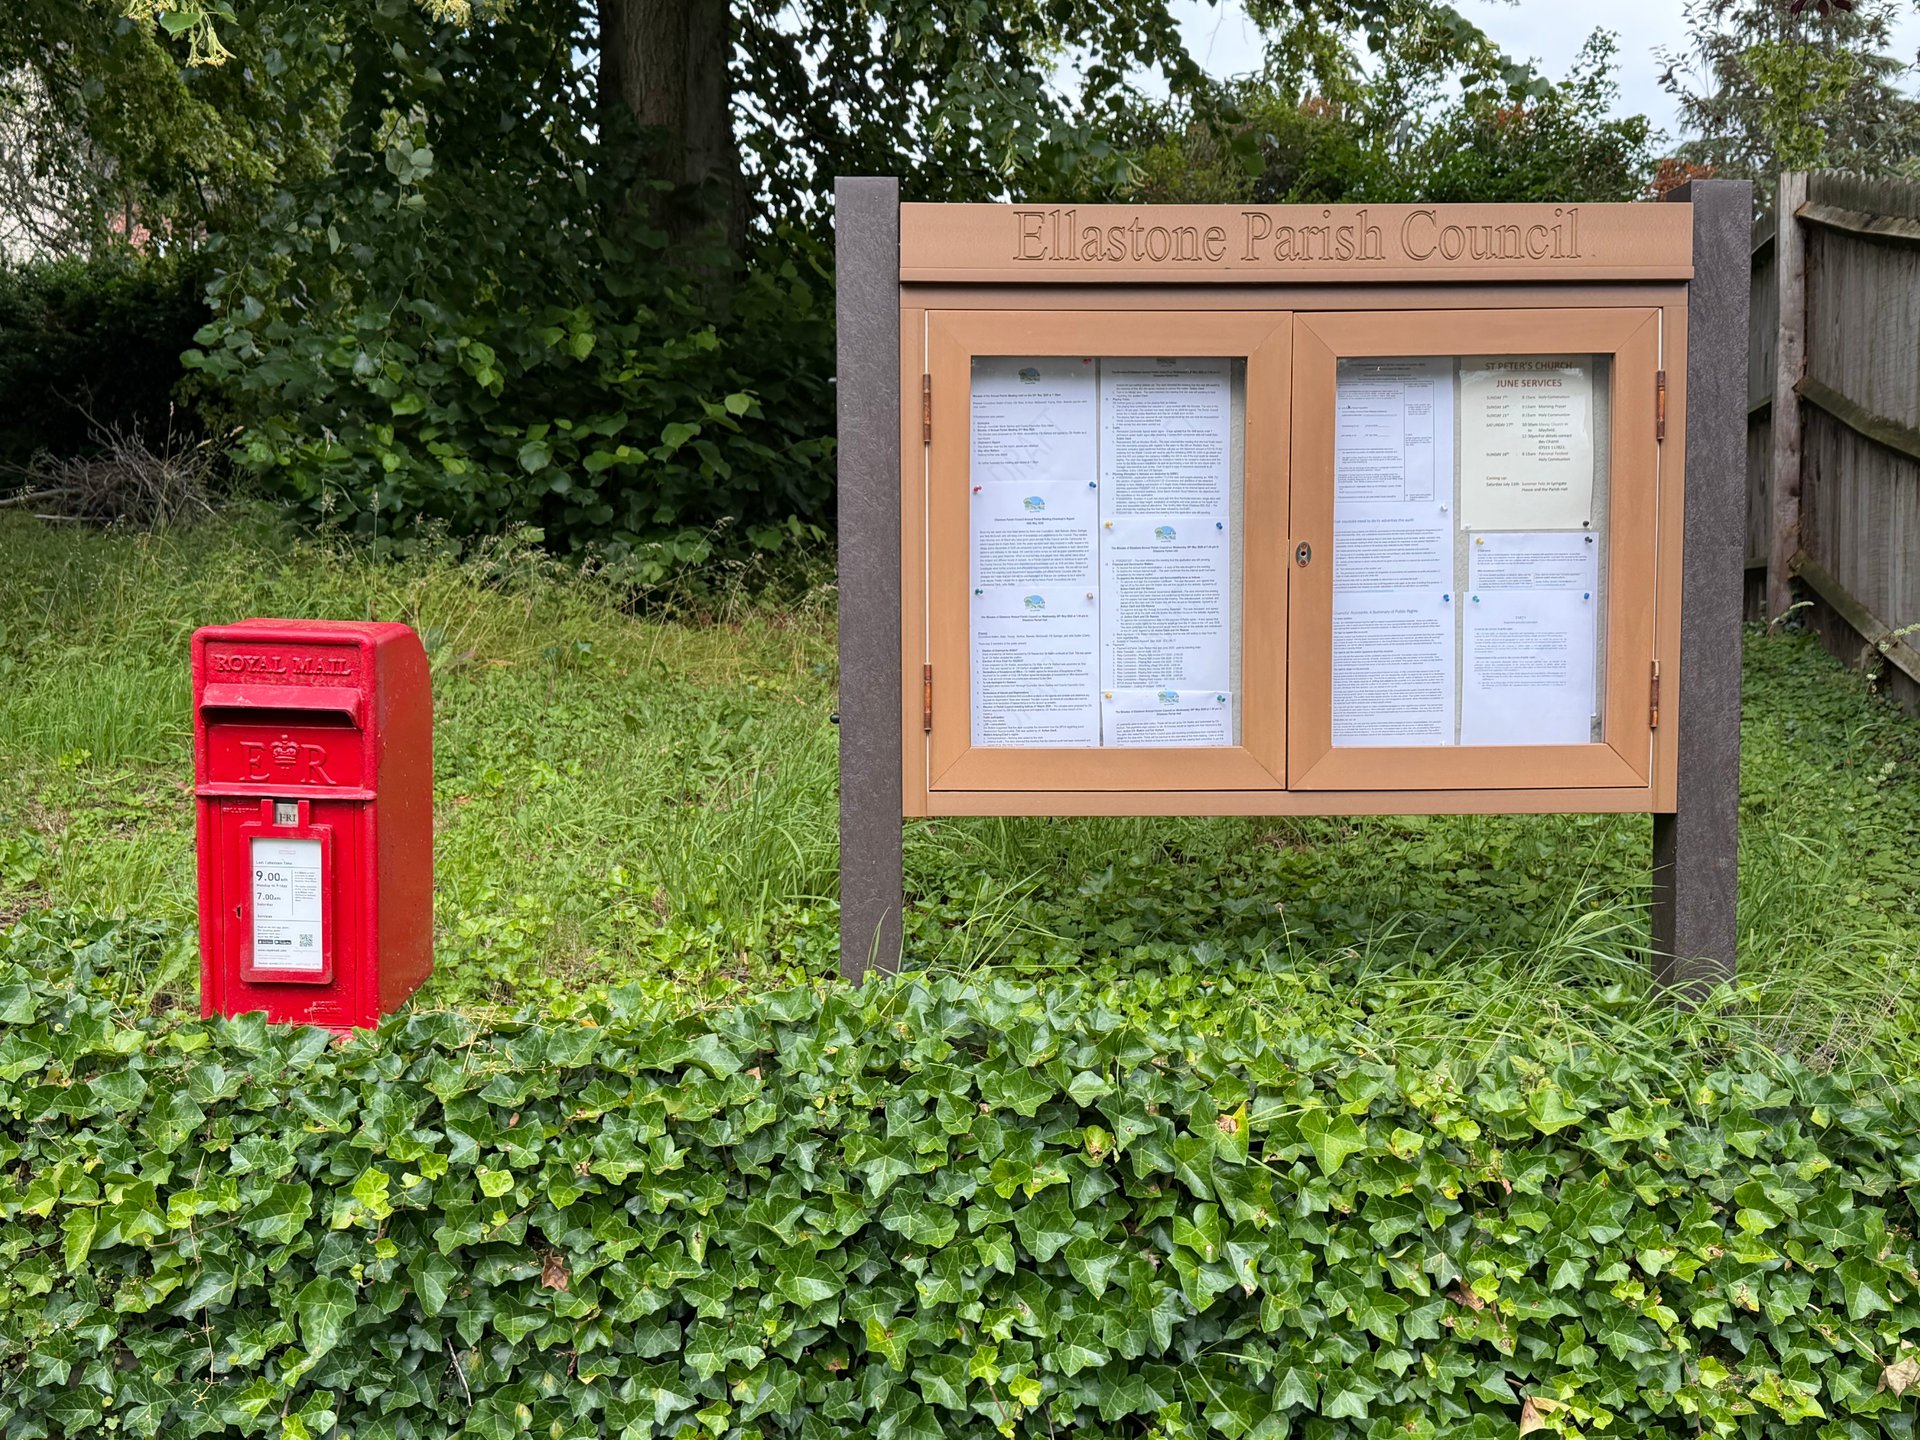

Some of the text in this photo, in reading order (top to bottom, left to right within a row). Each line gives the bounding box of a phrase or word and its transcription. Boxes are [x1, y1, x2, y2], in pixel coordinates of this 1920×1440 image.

[1012, 207, 1582, 262] Ellastone Parish Council
[1485, 361, 1572, 370] ST PETER'S CHURCH
[1496, 379, 1562, 388] JUNE SERVICES
[213, 654, 352, 677] ROYAL MAIL
[239, 741, 337, 785] E R
[279, 813, 297, 823] FRI
